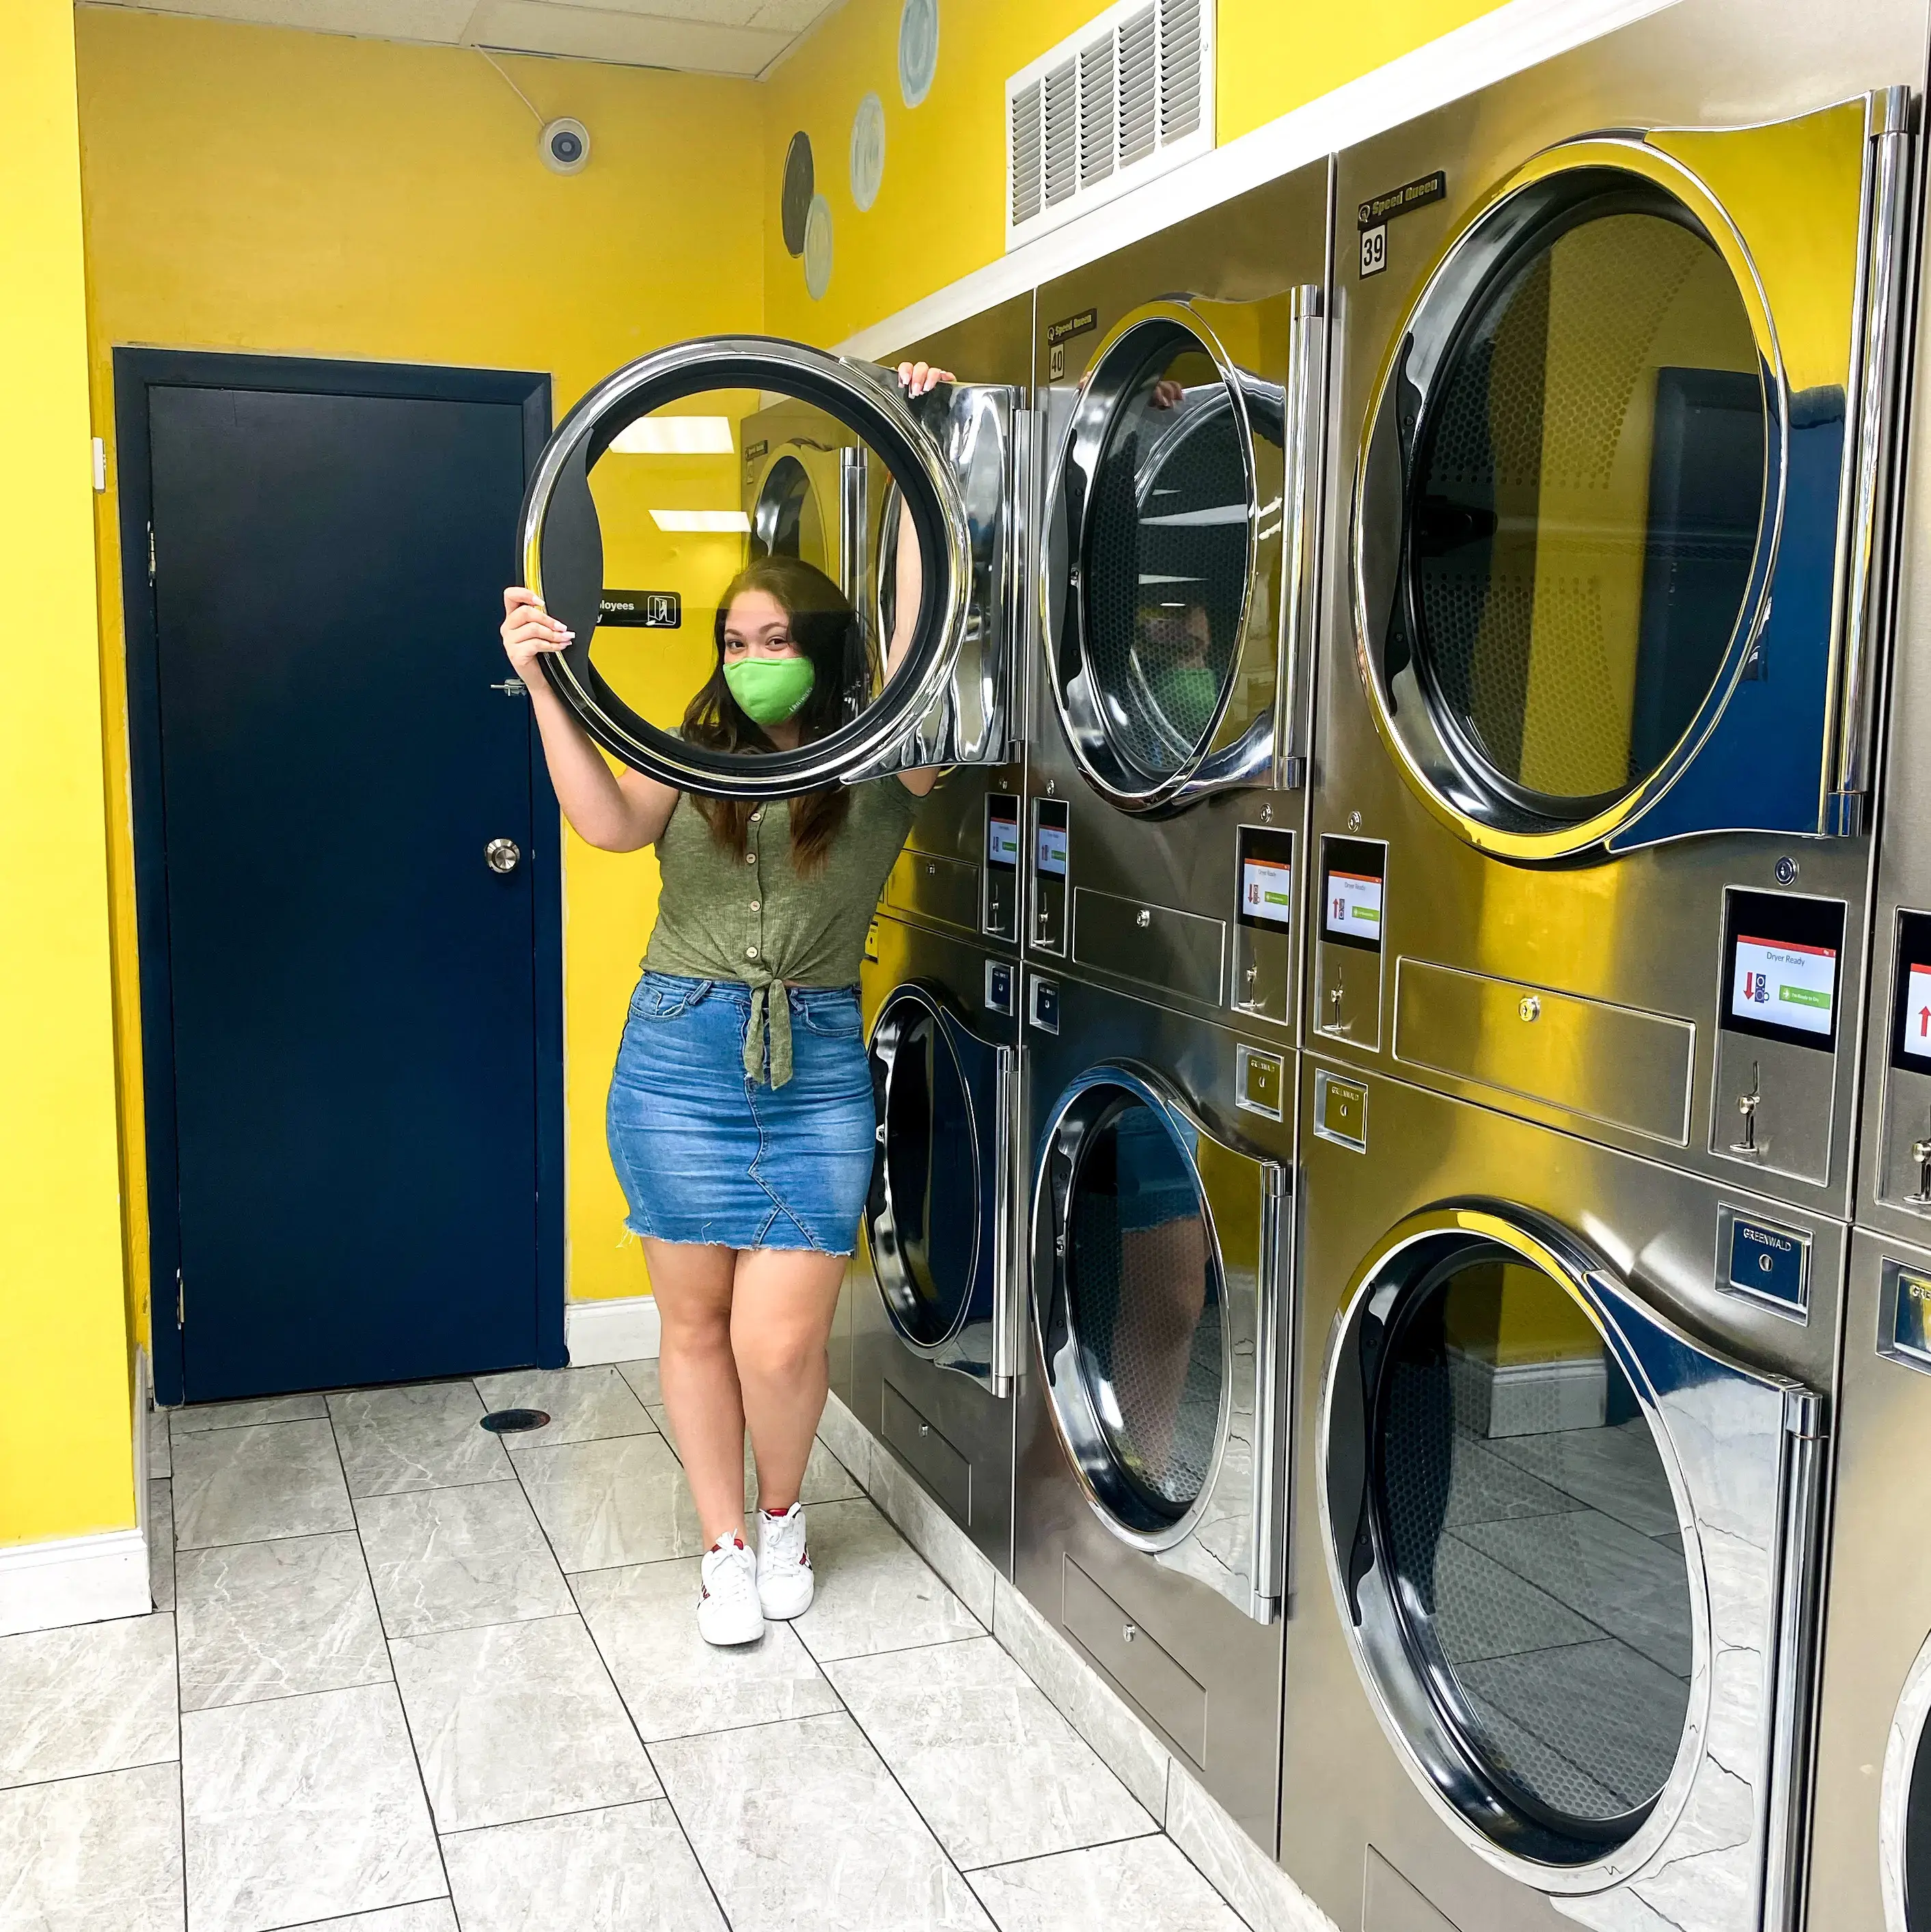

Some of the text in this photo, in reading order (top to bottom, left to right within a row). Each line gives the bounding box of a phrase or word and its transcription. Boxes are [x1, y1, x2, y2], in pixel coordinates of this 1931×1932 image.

[1372, 191, 1403, 216] Speed
[1405, 178, 1438, 202] Queen
[1364, 234, 1383, 266] 39
[1055, 320, 1073, 336] Speed
[1073, 314, 1092, 328] Queen
[1052, 351, 1063, 372] 40
[599, 599, 635, 612] loyees
[1766, 951, 1805, 966] Dryer Ready
[1743, 1227, 1792, 1252] GREENWALD
